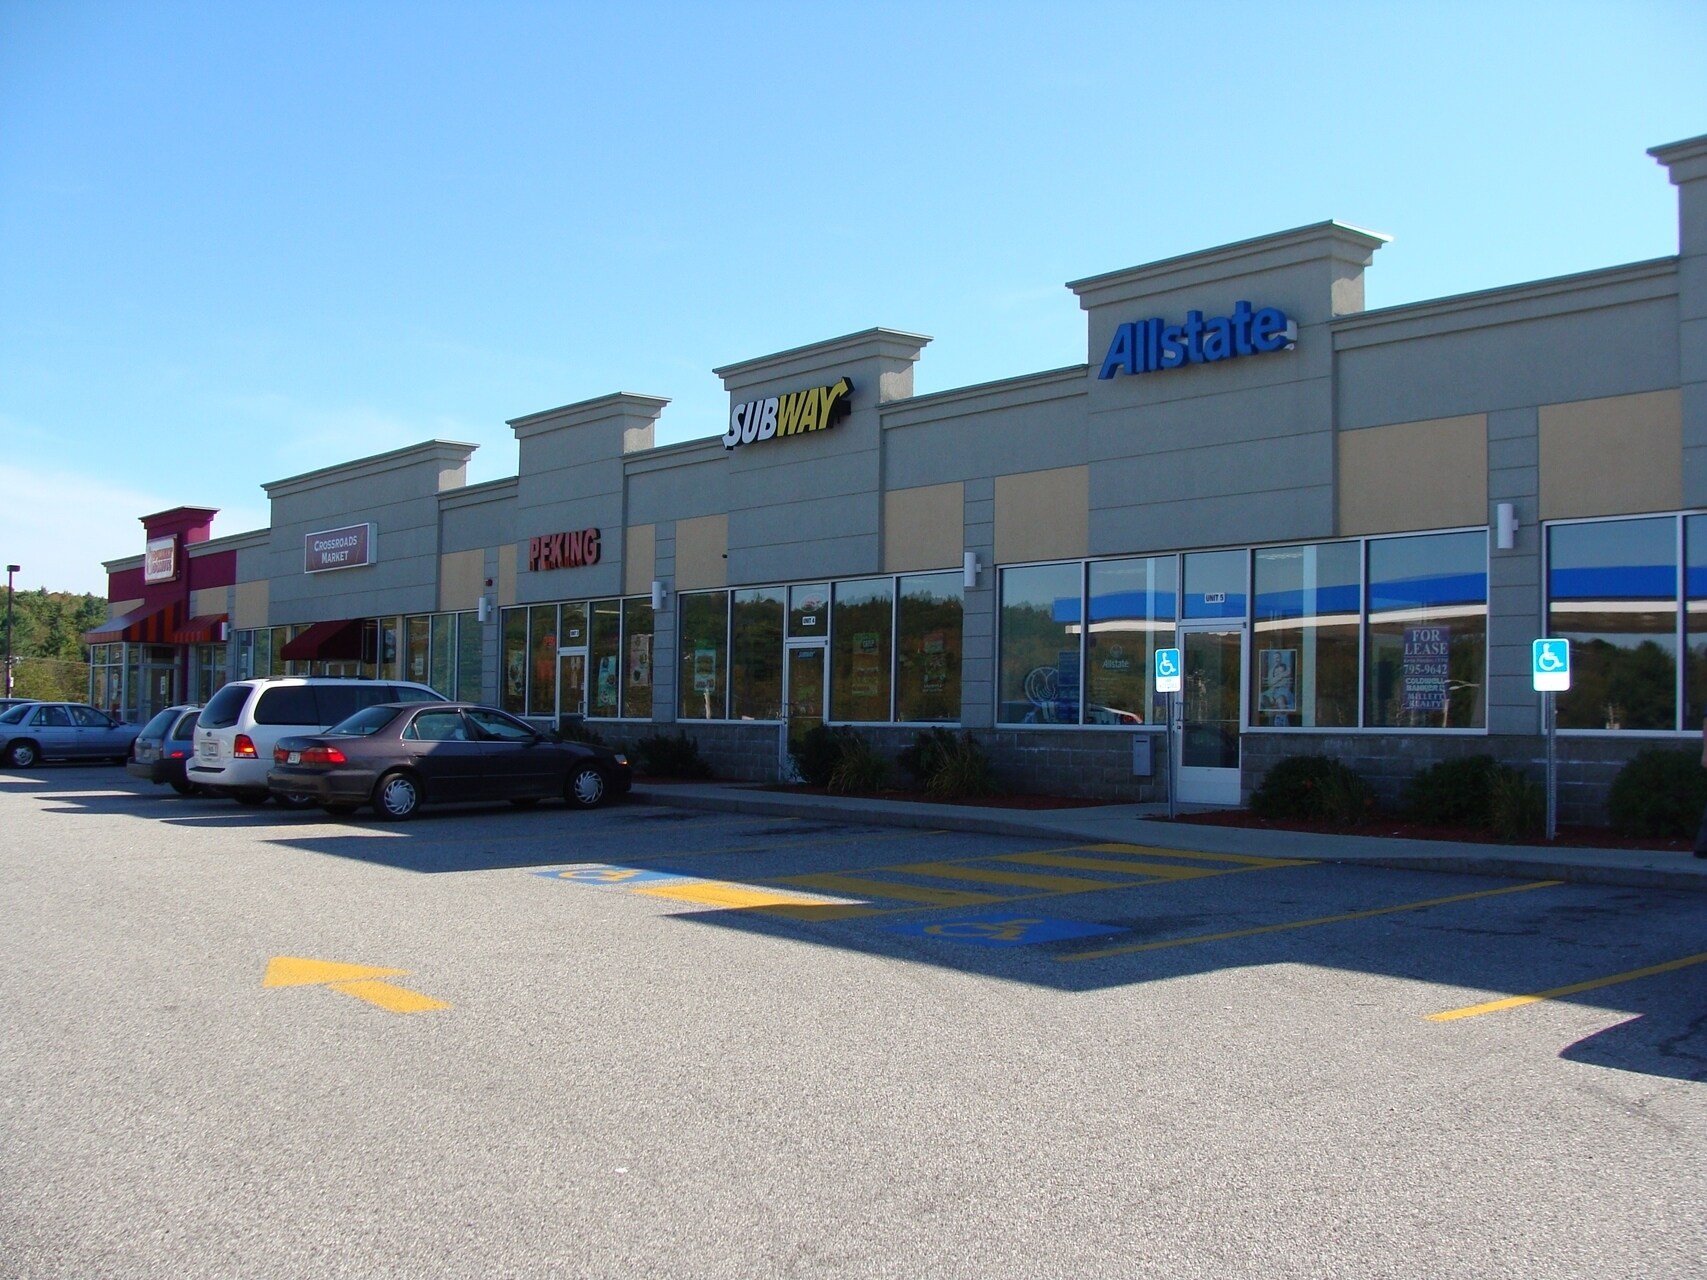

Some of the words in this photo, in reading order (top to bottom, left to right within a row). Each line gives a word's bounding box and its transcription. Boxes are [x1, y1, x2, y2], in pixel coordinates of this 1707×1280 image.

[1097, 300, 1287, 379] Allstate
[722, 378, 850, 449] SUBWAY
[528, 527, 601, 572] PEKING
[1205, 593, 1219, 602] UNIT
[1412, 629, 1441, 642] FOR
[1404, 642, 1448, 655] LEASE
[1403, 664, 1448, 675] 795-9642
